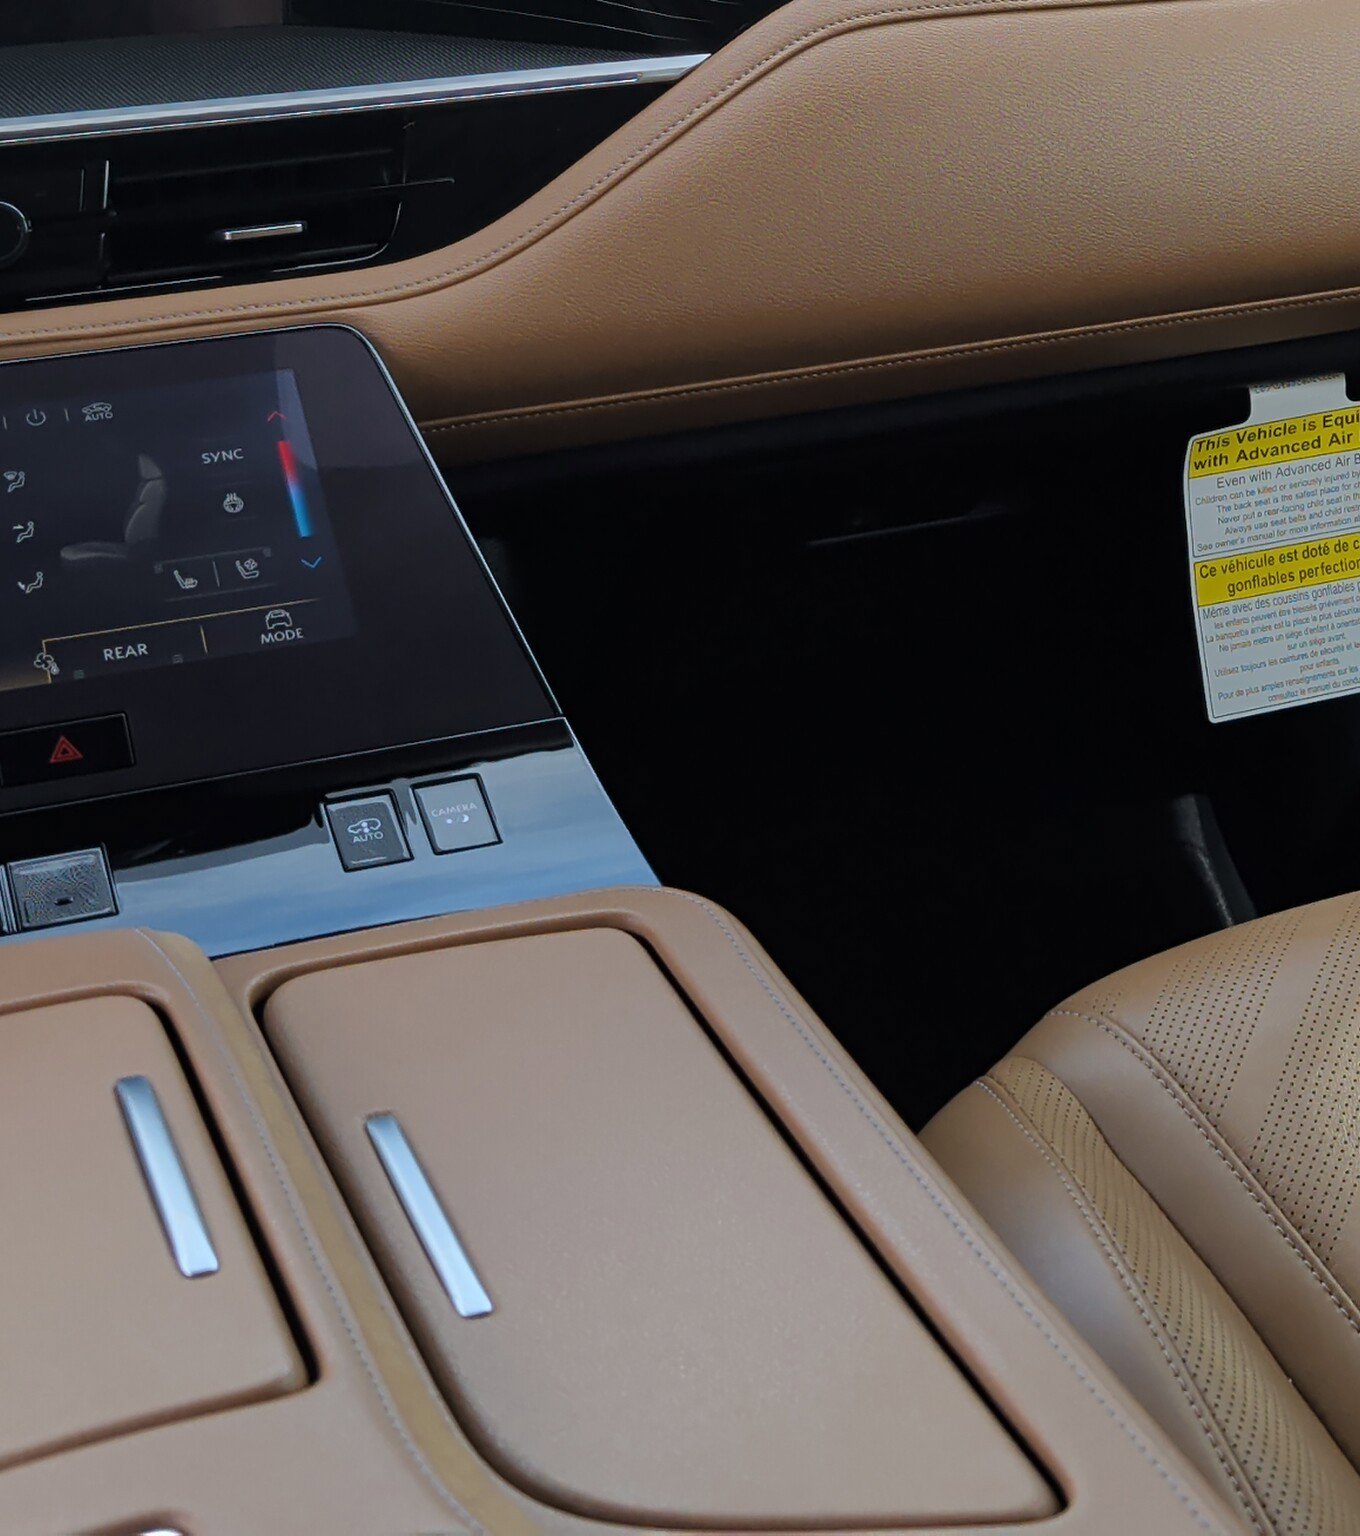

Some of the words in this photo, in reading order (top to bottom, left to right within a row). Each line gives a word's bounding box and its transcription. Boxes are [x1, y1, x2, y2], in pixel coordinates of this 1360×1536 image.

[84, 409, 113, 421] AUTO
[1193, 452, 1228, 470] with
[1235, 435, 1321, 463] Advanced
[1328, 429, 1353, 446] Air
[1196, 434, 1230, 453] This
[1235, 422, 1297, 444] Vehicle
[1302, 417, 1316, 431] is
[201, 448, 244, 465] SYNC
[1216, 473, 1245, 489] Even
[1249, 468, 1271, 483] with
[1275, 457, 1330, 478] Advanced
[1334, 454, 1350, 467] Air
[1195, 492, 1226, 505] Children
[1229, 491, 1243, 499] can
[1245, 488, 1255, 496] be
[1257, 484, 1277, 495] killed
[1289, 475, 1322, 491] seriously
[1323, 471, 1349, 484] injured
[1351, 469, 1360, 478] by
[1216, 503, 1231, 513] The
[1233, 499, 1251, 510] back
[1254, 497, 1270, 506] seat
[1272, 495, 1278, 503] is
[1281, 493, 1292, 501] the
[1295, 488, 1317, 499] safest
[1319, 484, 1339, 497] place
[1341, 482, 1351, 490] for
[1217, 513, 1239, 524] Never
[1242, 511, 1255, 522] put
[1306, 498, 1324, 508] child
[1326, 495, 1342, 505] seat
[1199, 563, 1216, 579] Ce
[1220, 553, 1274, 574] véhicule
[1278, 549, 1298, 563] est
[1301, 542, 1329, 559] doté
[1333, 538, 1348, 553] de
[1227, 569, 1295, 596] gonflables
[1202, 604, 1230, 619] Même
[1231, 601, 1251, 614] avec
[1255, 597, 1270, 609] des
[1272, 589, 1309, 606] coussins
[1311, 580, 1355, 601] gonflables
[260, 627, 304, 645] MODE
[103, 643, 148, 662] REAR
[431, 802, 478, 817] CAMERA
[353, 831, 384, 844] AUTO
